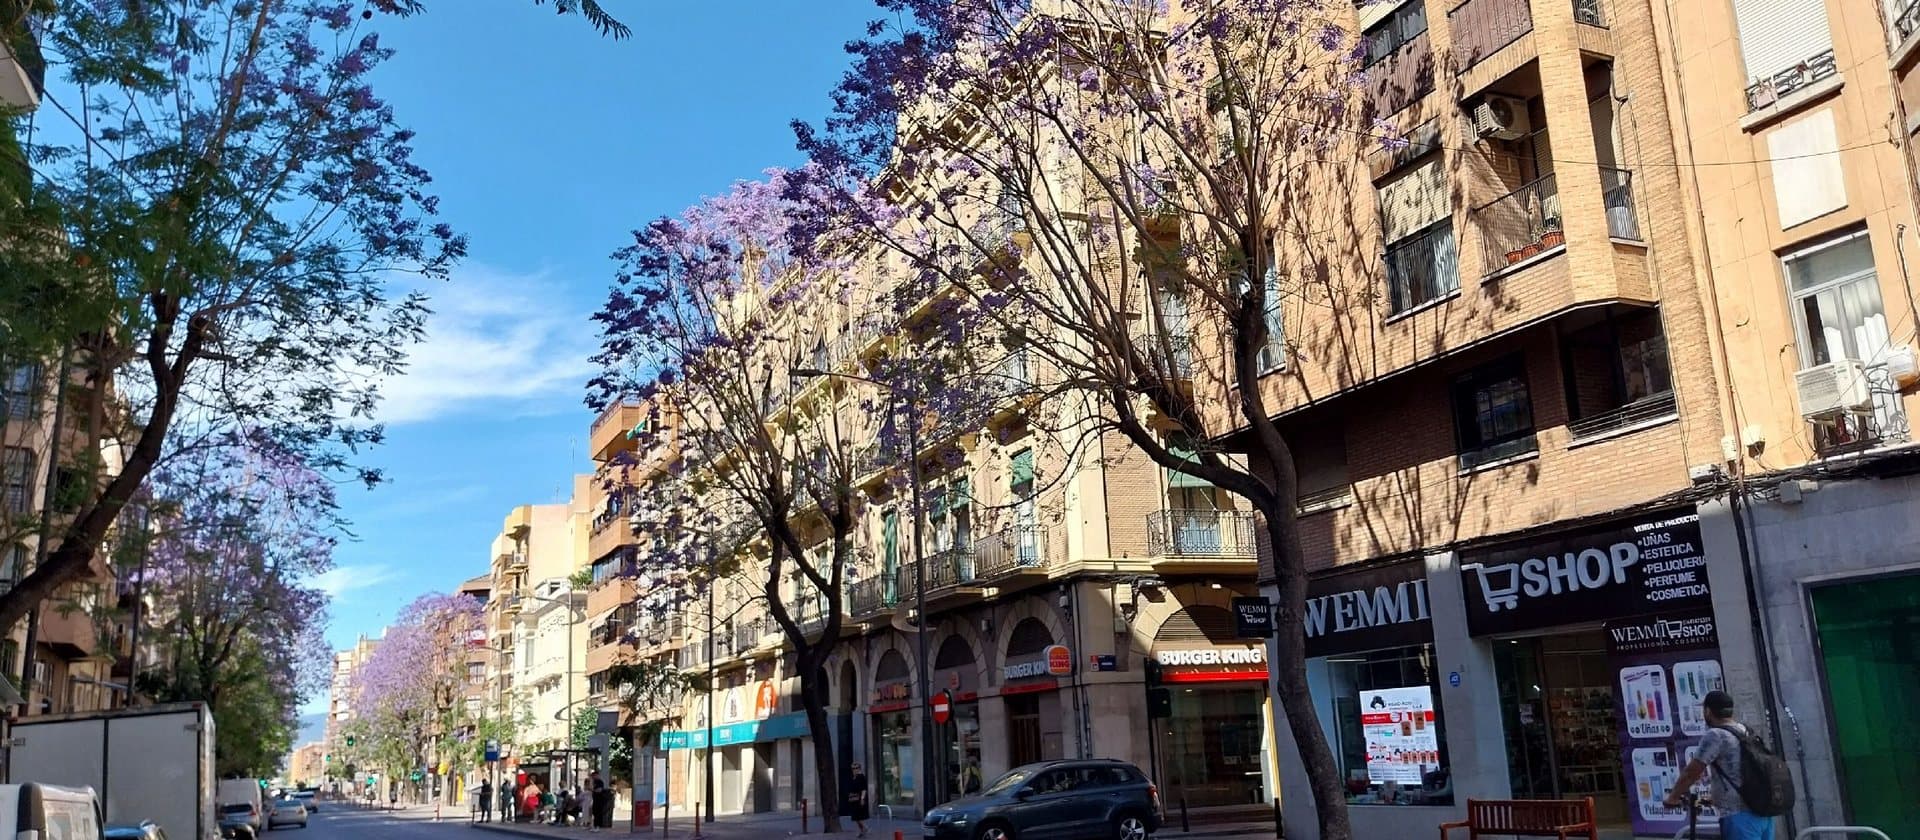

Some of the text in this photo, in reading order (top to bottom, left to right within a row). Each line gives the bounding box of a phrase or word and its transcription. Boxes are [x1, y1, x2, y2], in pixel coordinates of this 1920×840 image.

[1665, 514, 1700, 527] PRODUCTO
[1642, 532, 1671, 547] UÑAS
[1644, 542, 1694, 560] ESTETICA
[1521, 542, 1642, 598] SHOP
[1649, 571, 1697, 588] PERFUME
[1651, 584, 1709, 601] COSMETICA
[1303, 578, 1431, 638] WEMMI
[1611, 623, 1713, 642] WEMMI SHOP
[1157, 648, 1262, 666] BURGER KING
[1004, 660, 1048, 680] BURGER KIN
